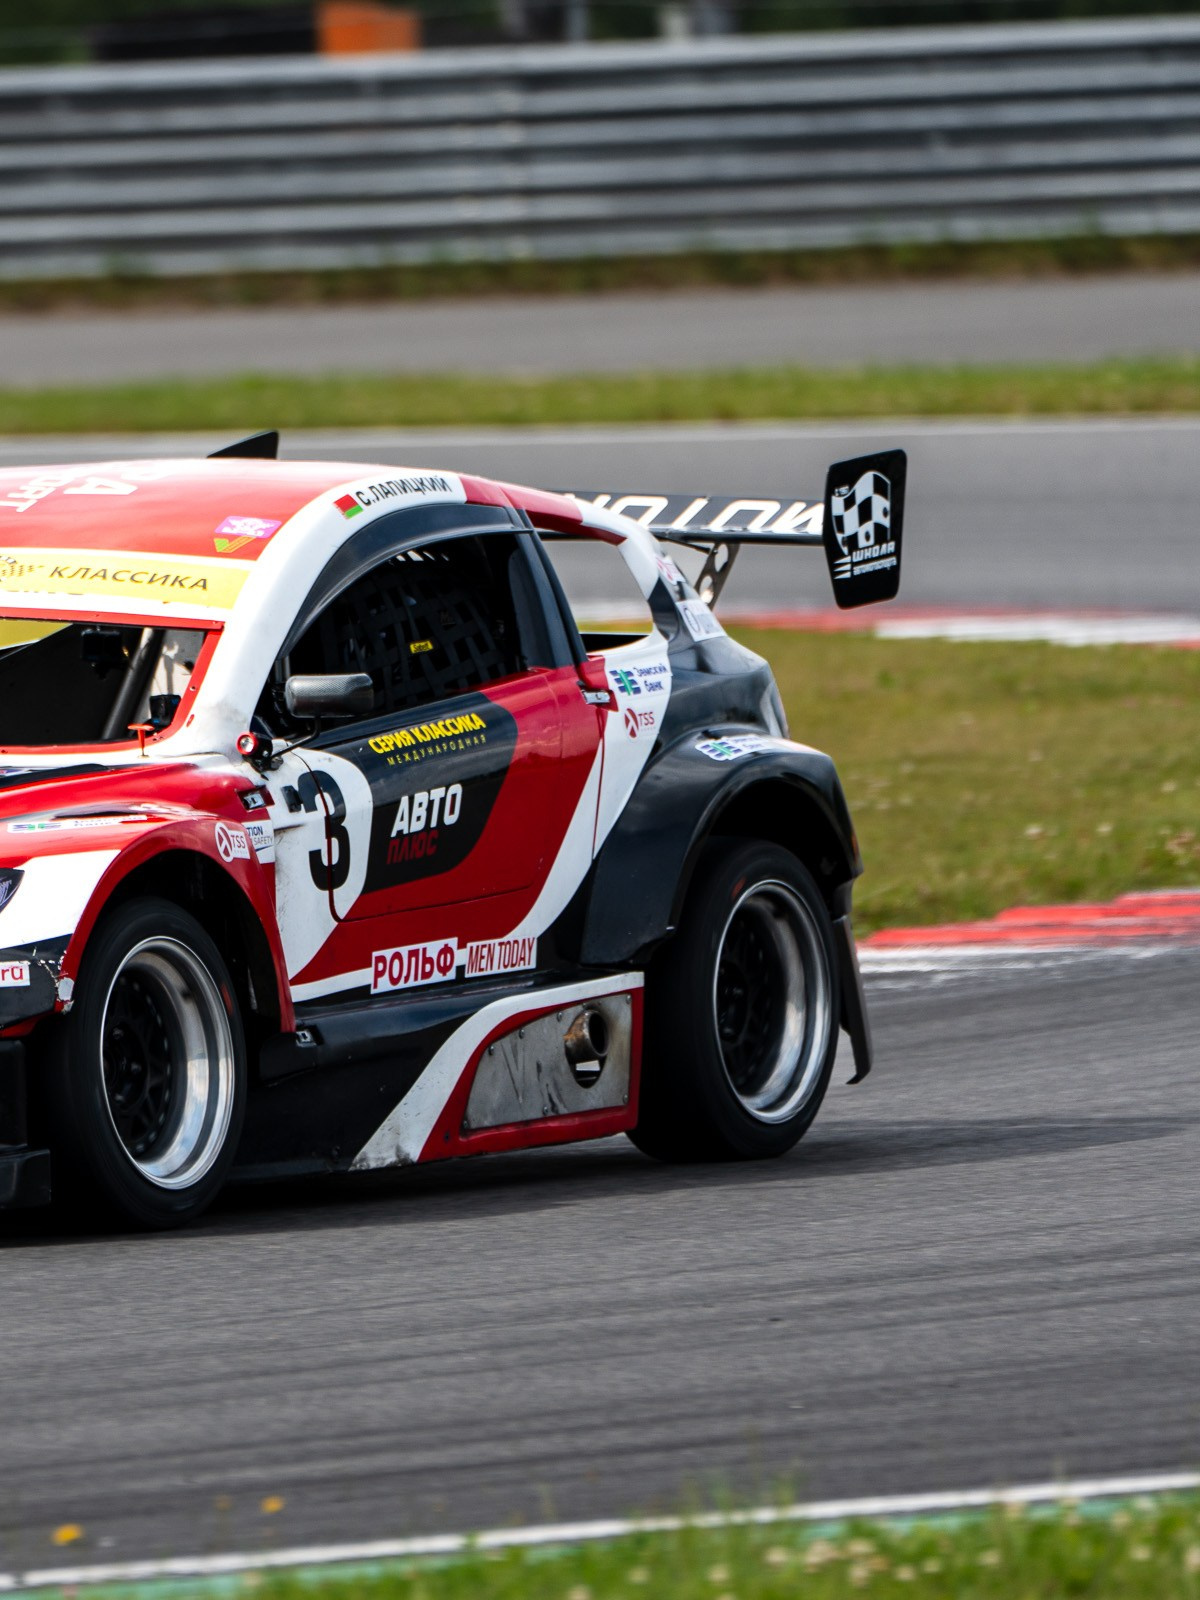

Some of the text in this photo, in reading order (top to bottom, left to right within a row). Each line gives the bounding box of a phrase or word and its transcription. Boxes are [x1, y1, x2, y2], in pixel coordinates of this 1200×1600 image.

[48, 565, 209, 592] КЛАССИКА
[367, 712, 487, 754] СЕРИЯ КЛАССИКА
[638, 711, 655, 727] TSS
[386, 734, 487, 767] МЕЖДУНАРОДНАЯ
[390, 782, 463, 838] АВТО
[230, 834, 246, 849] TSS
[297, 769, 351, 891] 3
[386, 828, 440, 865] ПЛЮС
[372, 943, 455, 990] РОЛЬФ
[466, 937, 536, 975] MEN TODAY
